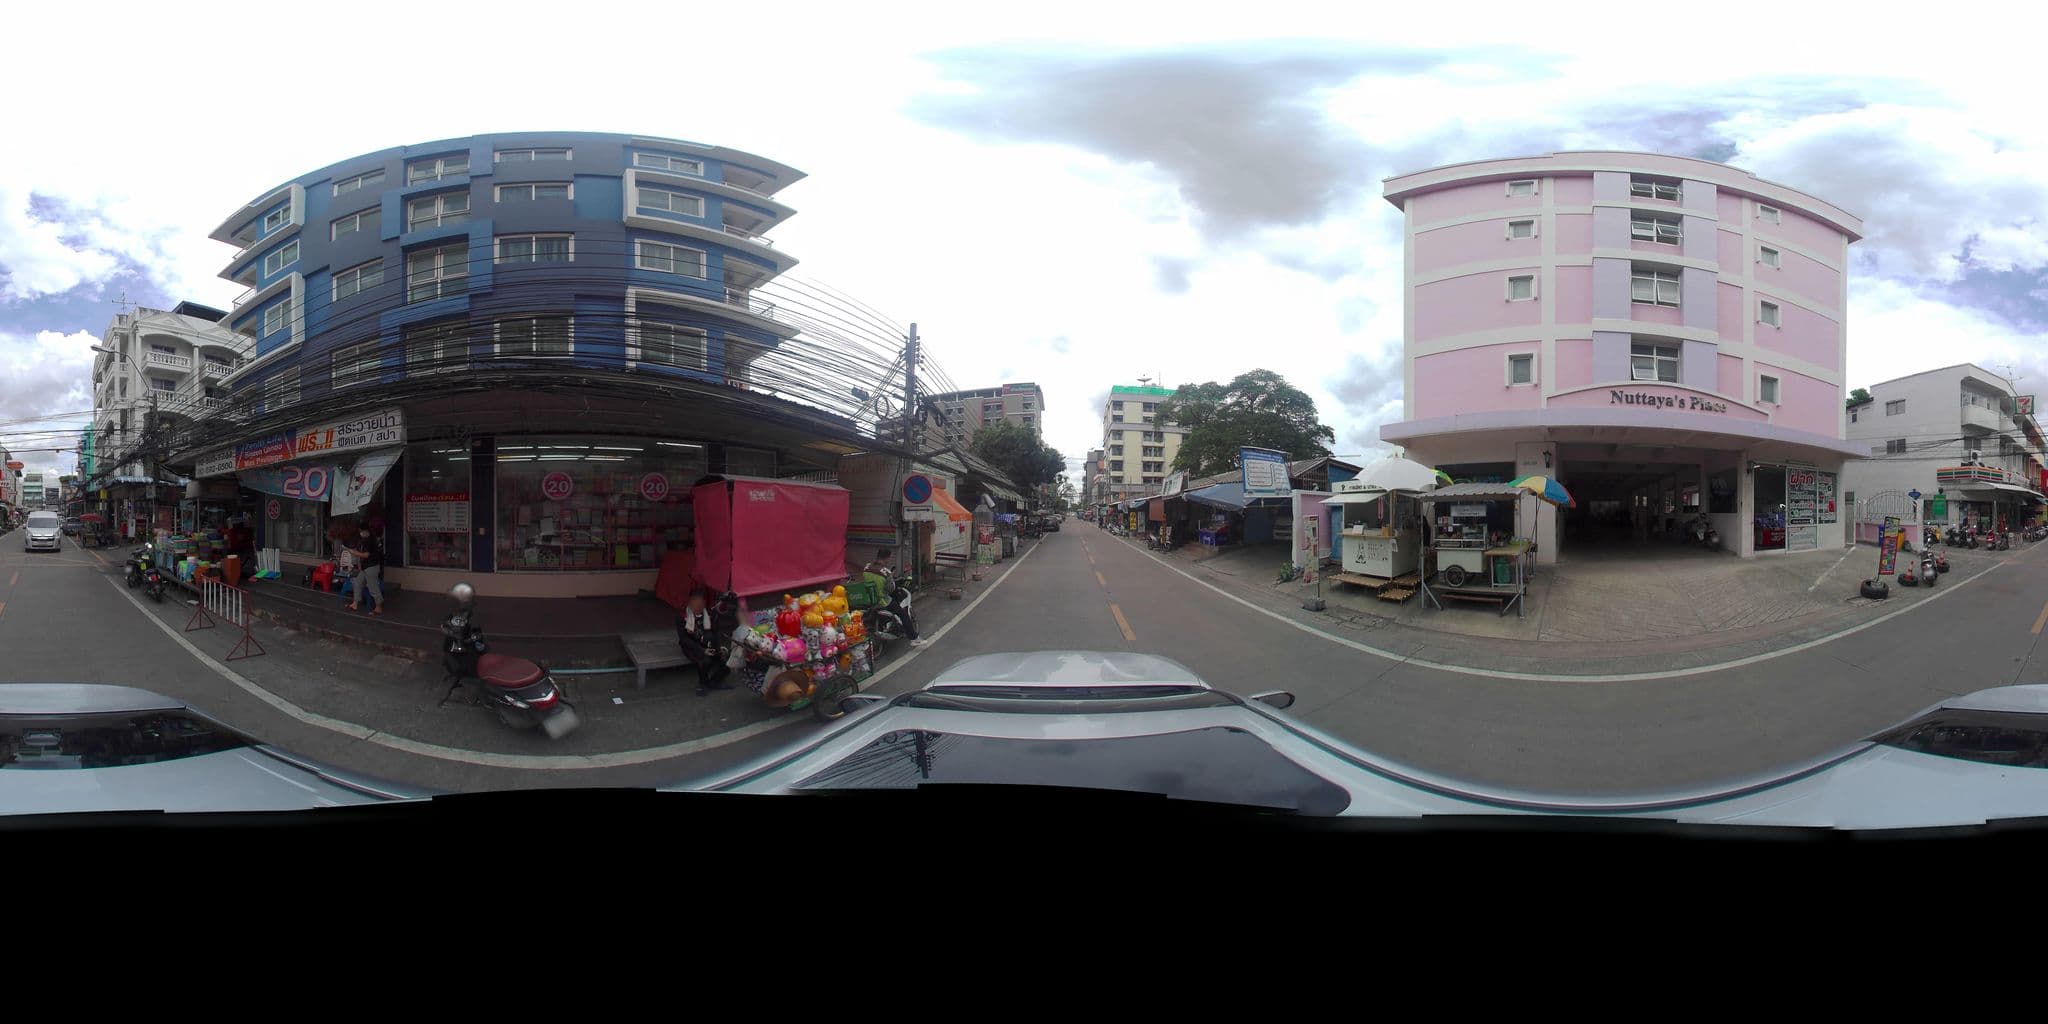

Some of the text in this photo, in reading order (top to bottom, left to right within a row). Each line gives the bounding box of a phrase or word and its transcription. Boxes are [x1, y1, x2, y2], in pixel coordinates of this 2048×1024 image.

[1610, 390, 1726, 413] Nuttaya's Place
[283, 466, 328, 498] 20
[547, 480, 569, 493] 20
[646, 482, 665, 493] 20
